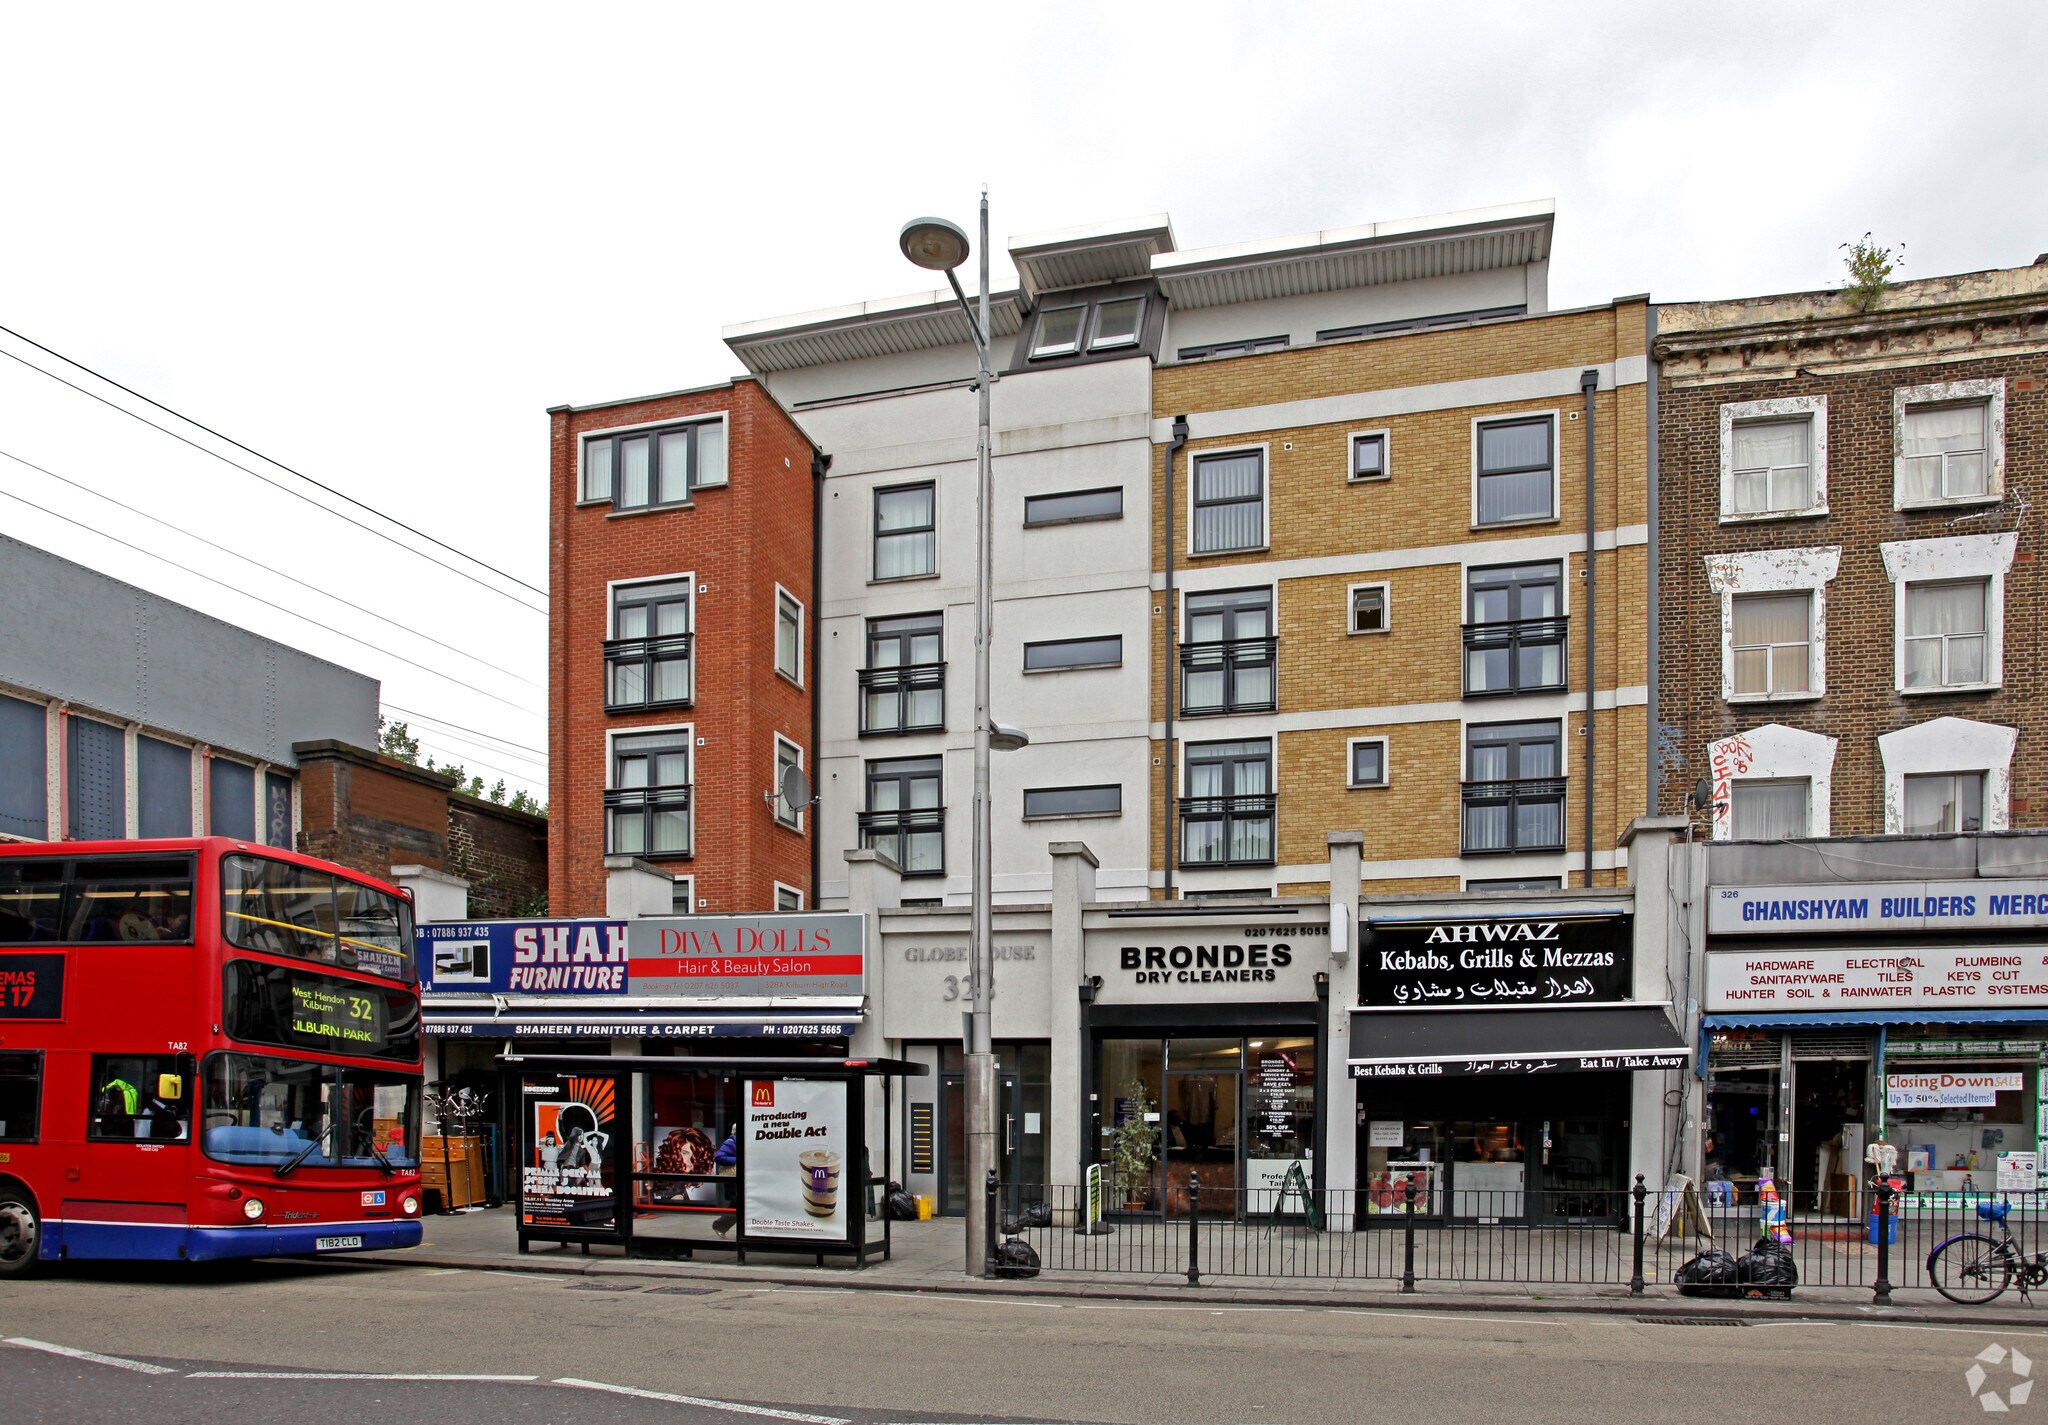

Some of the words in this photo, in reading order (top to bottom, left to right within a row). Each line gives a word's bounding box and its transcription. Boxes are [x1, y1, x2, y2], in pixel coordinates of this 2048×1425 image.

[1742, 899, 1868, 922] GHANSHYAM
[1880, 895, 1976, 918] BUILDERS
[1989, 894, 2048, 916] MERC
[432, 928, 456, 938] 07886
[458, 928, 472, 937] 937
[474, 927, 489, 936] 435
[1244, 928, 1266, 937] 020
[1269, 928, 1297, 937] 7625
[1300, 926, 1329, 936] 5055
[1425, 923, 1560, 944] AHWAZ
[658, 928, 724, 955] DIVA
[734, 927, 831, 954] DOLLS
[904, 947, 968, 962] GLOBE
[993, 946, 1035, 961] OUSE
[1120, 944, 1292, 970] BRONDES
[1380, 950, 1455, 972] Kebabs,
[1460, 948, 1514, 968] Grills
[1519, 948, 1538, 968] &
[1543, 948, 1614, 968] Mezzas
[678, 960, 708, 974] Hair
[711, 960, 721, 974] &
[724, 959, 770, 976] Beauty
[773, 958, 811, 973] Salon
[1745, 960, 1814, 971] HARDWARE
[1846, 957, 1925, 969] ELECTRICAL
[1955, 956, 2022, 967] PLUMBING
[510, 966, 625, 991] FURNITURE
[1136, 972, 1172, 984] DRY
[1177, 968, 1276, 984] CLEANERS
[1750, 974, 1844, 985] SANITARYWARE
[1877, 972, 1914, 982] TILES
[1948, 971, 1982, 981] KEYS
[1992, 970, 2020, 980] CUT
[642, 982, 672, 990] Bookings
[812, 981, 830, 989] High
[830, 980, 848, 988] Road
[943, 975, 996, 1002] 32
[1726, 989, 1775, 999] HUNTER
[1786, 988, 1814, 998] SOIL
[1822, 988, 1830, 998] &
[1841, 986, 1912, 998] RAINWATER
[1923, 986, 1976, 996] PLASTIC
[1988, 984, 2048, 994] SYSTEMS
[12, 986, 35, 1007] 17
[314, 991, 346, 1005] Hendon
[303, 998, 334, 1012] Kilburn
[349, 996, 372, 1020] 32
[344, 1028, 372, 1042] PARK
[425, 1025, 446, 1034] 07886
[446, 1025, 460, 1034] 937
[460, 1025, 472, 1034] 435
[515, 1026, 572, 1034] SHAHEEN
[576, 1026, 646, 1034] FURNITURE
[652, 1026, 662, 1034] &
[665, 1026, 715, 1034] CARPET
[762, 1026, 776, 1034] PH
[782, 1026, 818, 1034] 0207625
[820, 1026, 842, 1034] 5665
[168, 1042, 188, 1050] TA82
[1580, 1058, 1599, 1068] Eat
[1601, 1058, 1614, 1068] In
[1623, 1056, 1650, 1067] Take
[1652, 1056, 1684, 1068] Away
[1354, 1066, 1372, 1076] Best
[1374, 1065, 1406, 1076] Kebabs
[1408, 1064, 1416, 1074] &
[1418, 1064, 1442, 1074] Grills
[1887, 1075, 1938, 1091] Closing
[1940, 1074, 1994, 1088] Down
[1994, 1076, 2022, 1087] SALE
[1890, 1094, 1902, 1106] Up
[1904, 1094, 1913, 1104] To
[1916, 1094, 1938, 1104] 50%
[1940, 1093, 1968, 1104] Selected
[1968, 1092, 1995, 1104] Items!!
[751, 1111, 807, 1122] Introducing
[756, 1128, 802, 1140] Double
[804, 1126, 827, 1138] Act
[401, 1168, 416, 1176] TA82
[792, 1220, 816, 1228] Shakes.
[320, 1238, 340, 1248] T182
